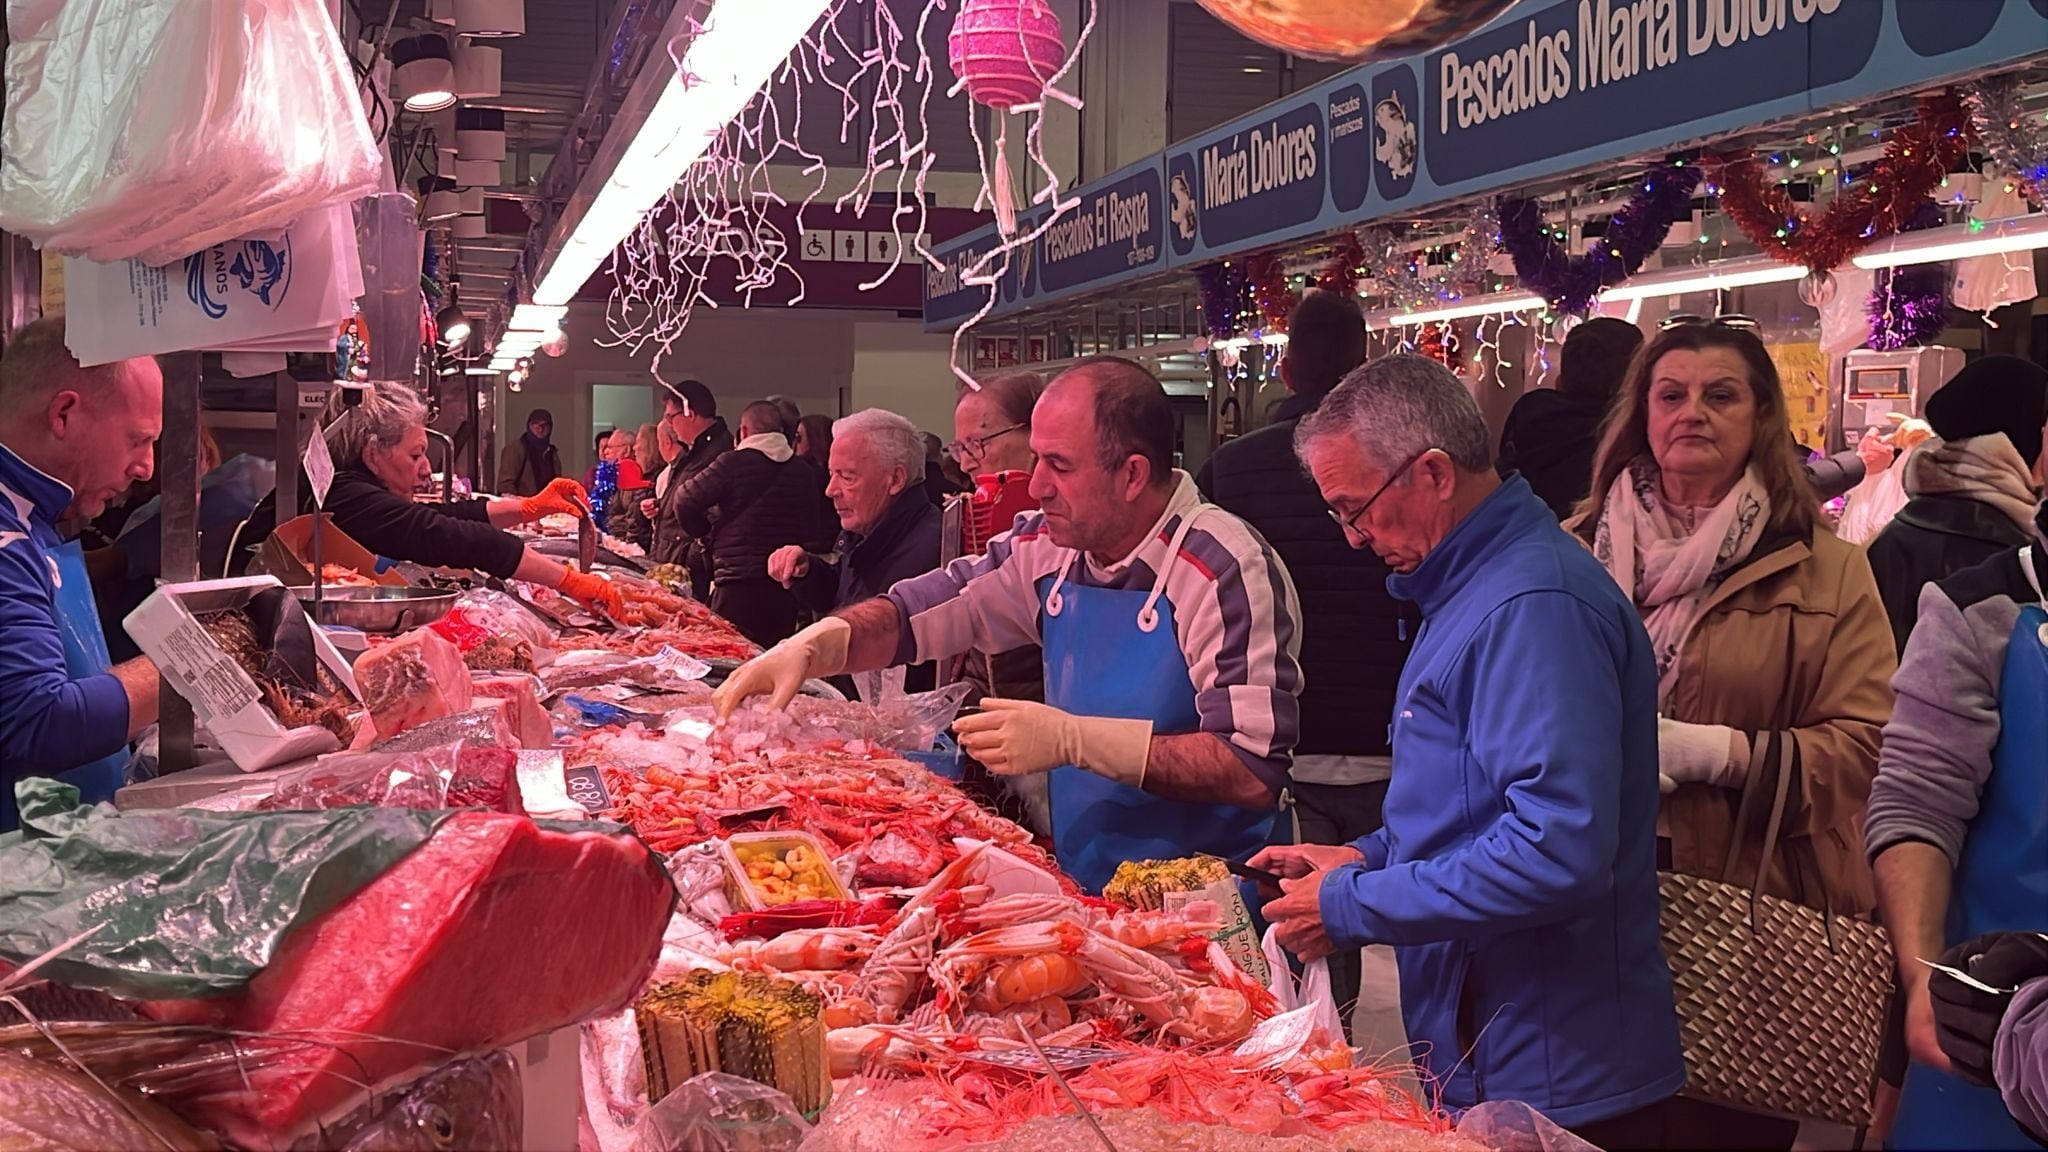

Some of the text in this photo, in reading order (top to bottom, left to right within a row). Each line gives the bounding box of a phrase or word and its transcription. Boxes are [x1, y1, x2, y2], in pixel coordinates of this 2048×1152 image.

[1330, 96, 1360, 119] Pescados
[1441, 20, 1571, 134] Pescados
[1203, 122, 1316, 210] María Dolores
[1044, 191, 1149, 264] Pescados El Raspa
